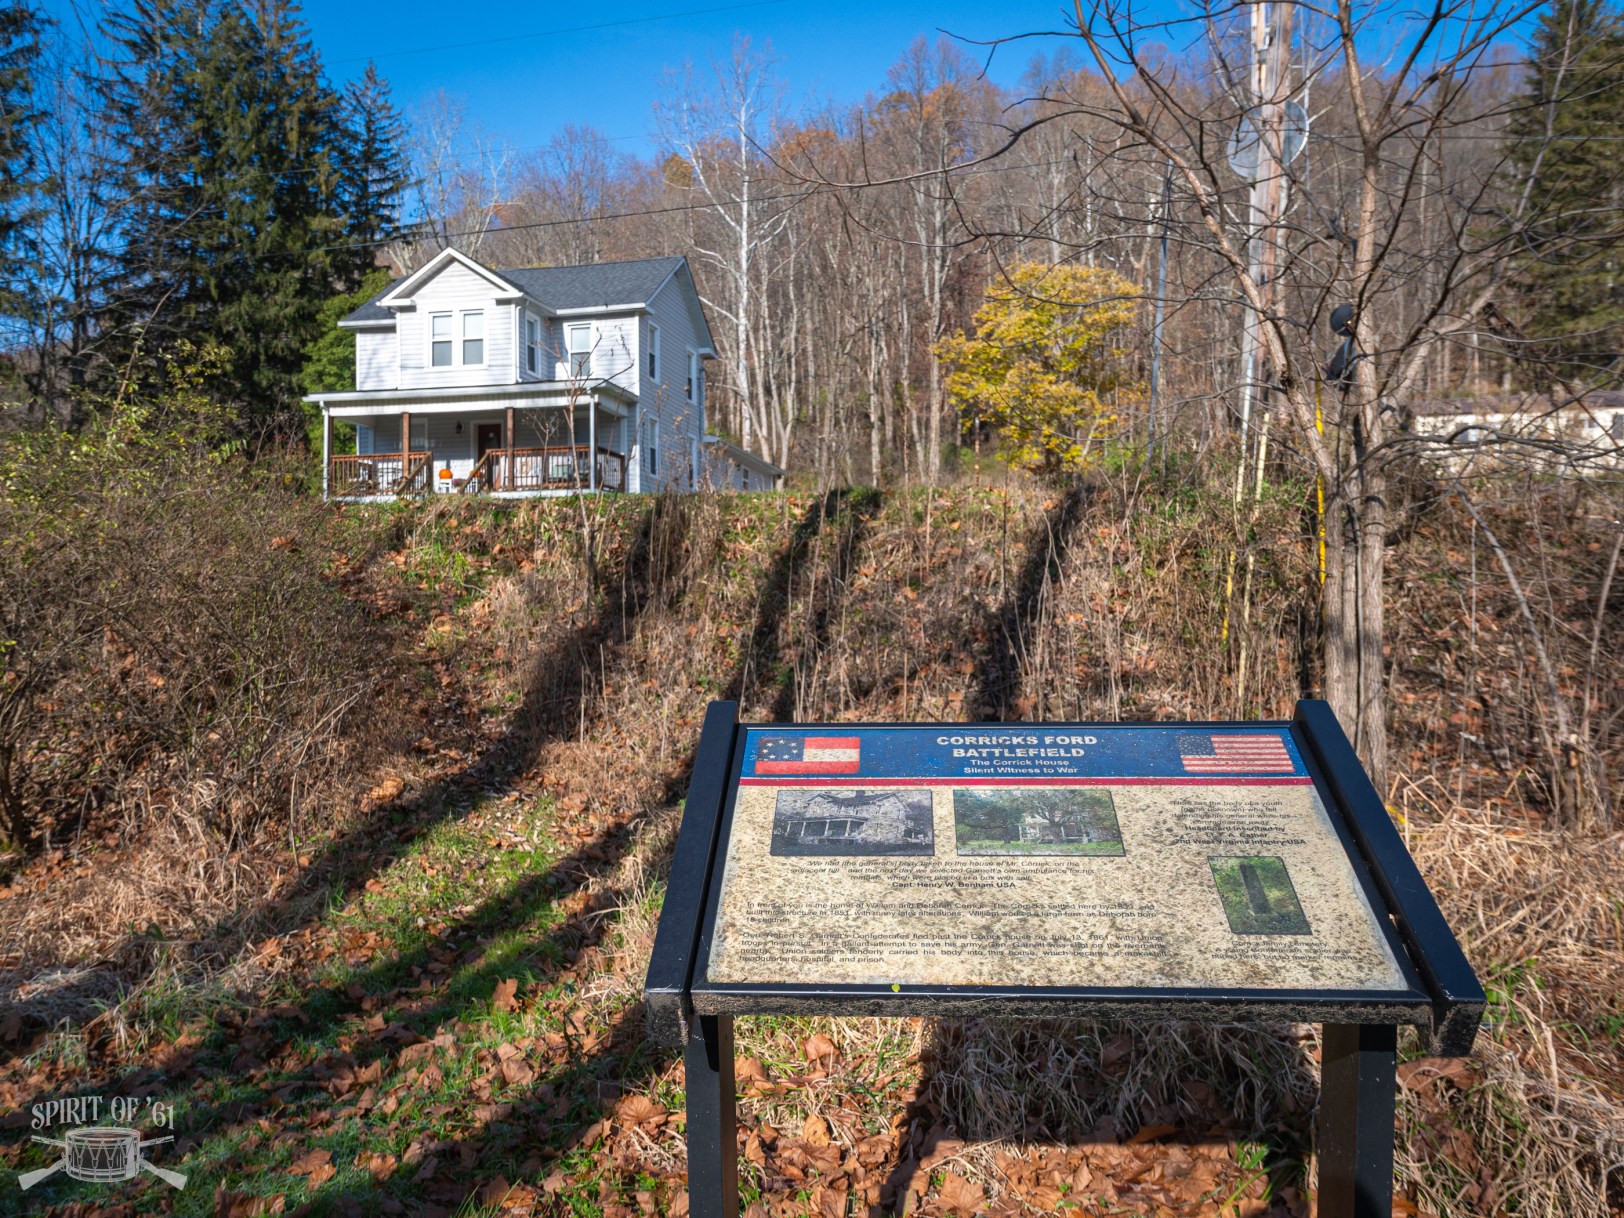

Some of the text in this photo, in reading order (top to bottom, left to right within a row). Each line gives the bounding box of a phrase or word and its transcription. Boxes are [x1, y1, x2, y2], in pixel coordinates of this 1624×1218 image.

[936, 736, 1098, 745] CORRICKS FORD
[953, 748, 1085, 757] BATTLEFIELD
[892, 882, 914, 890] Capt.
[917, 882, 942, 890] Henry
